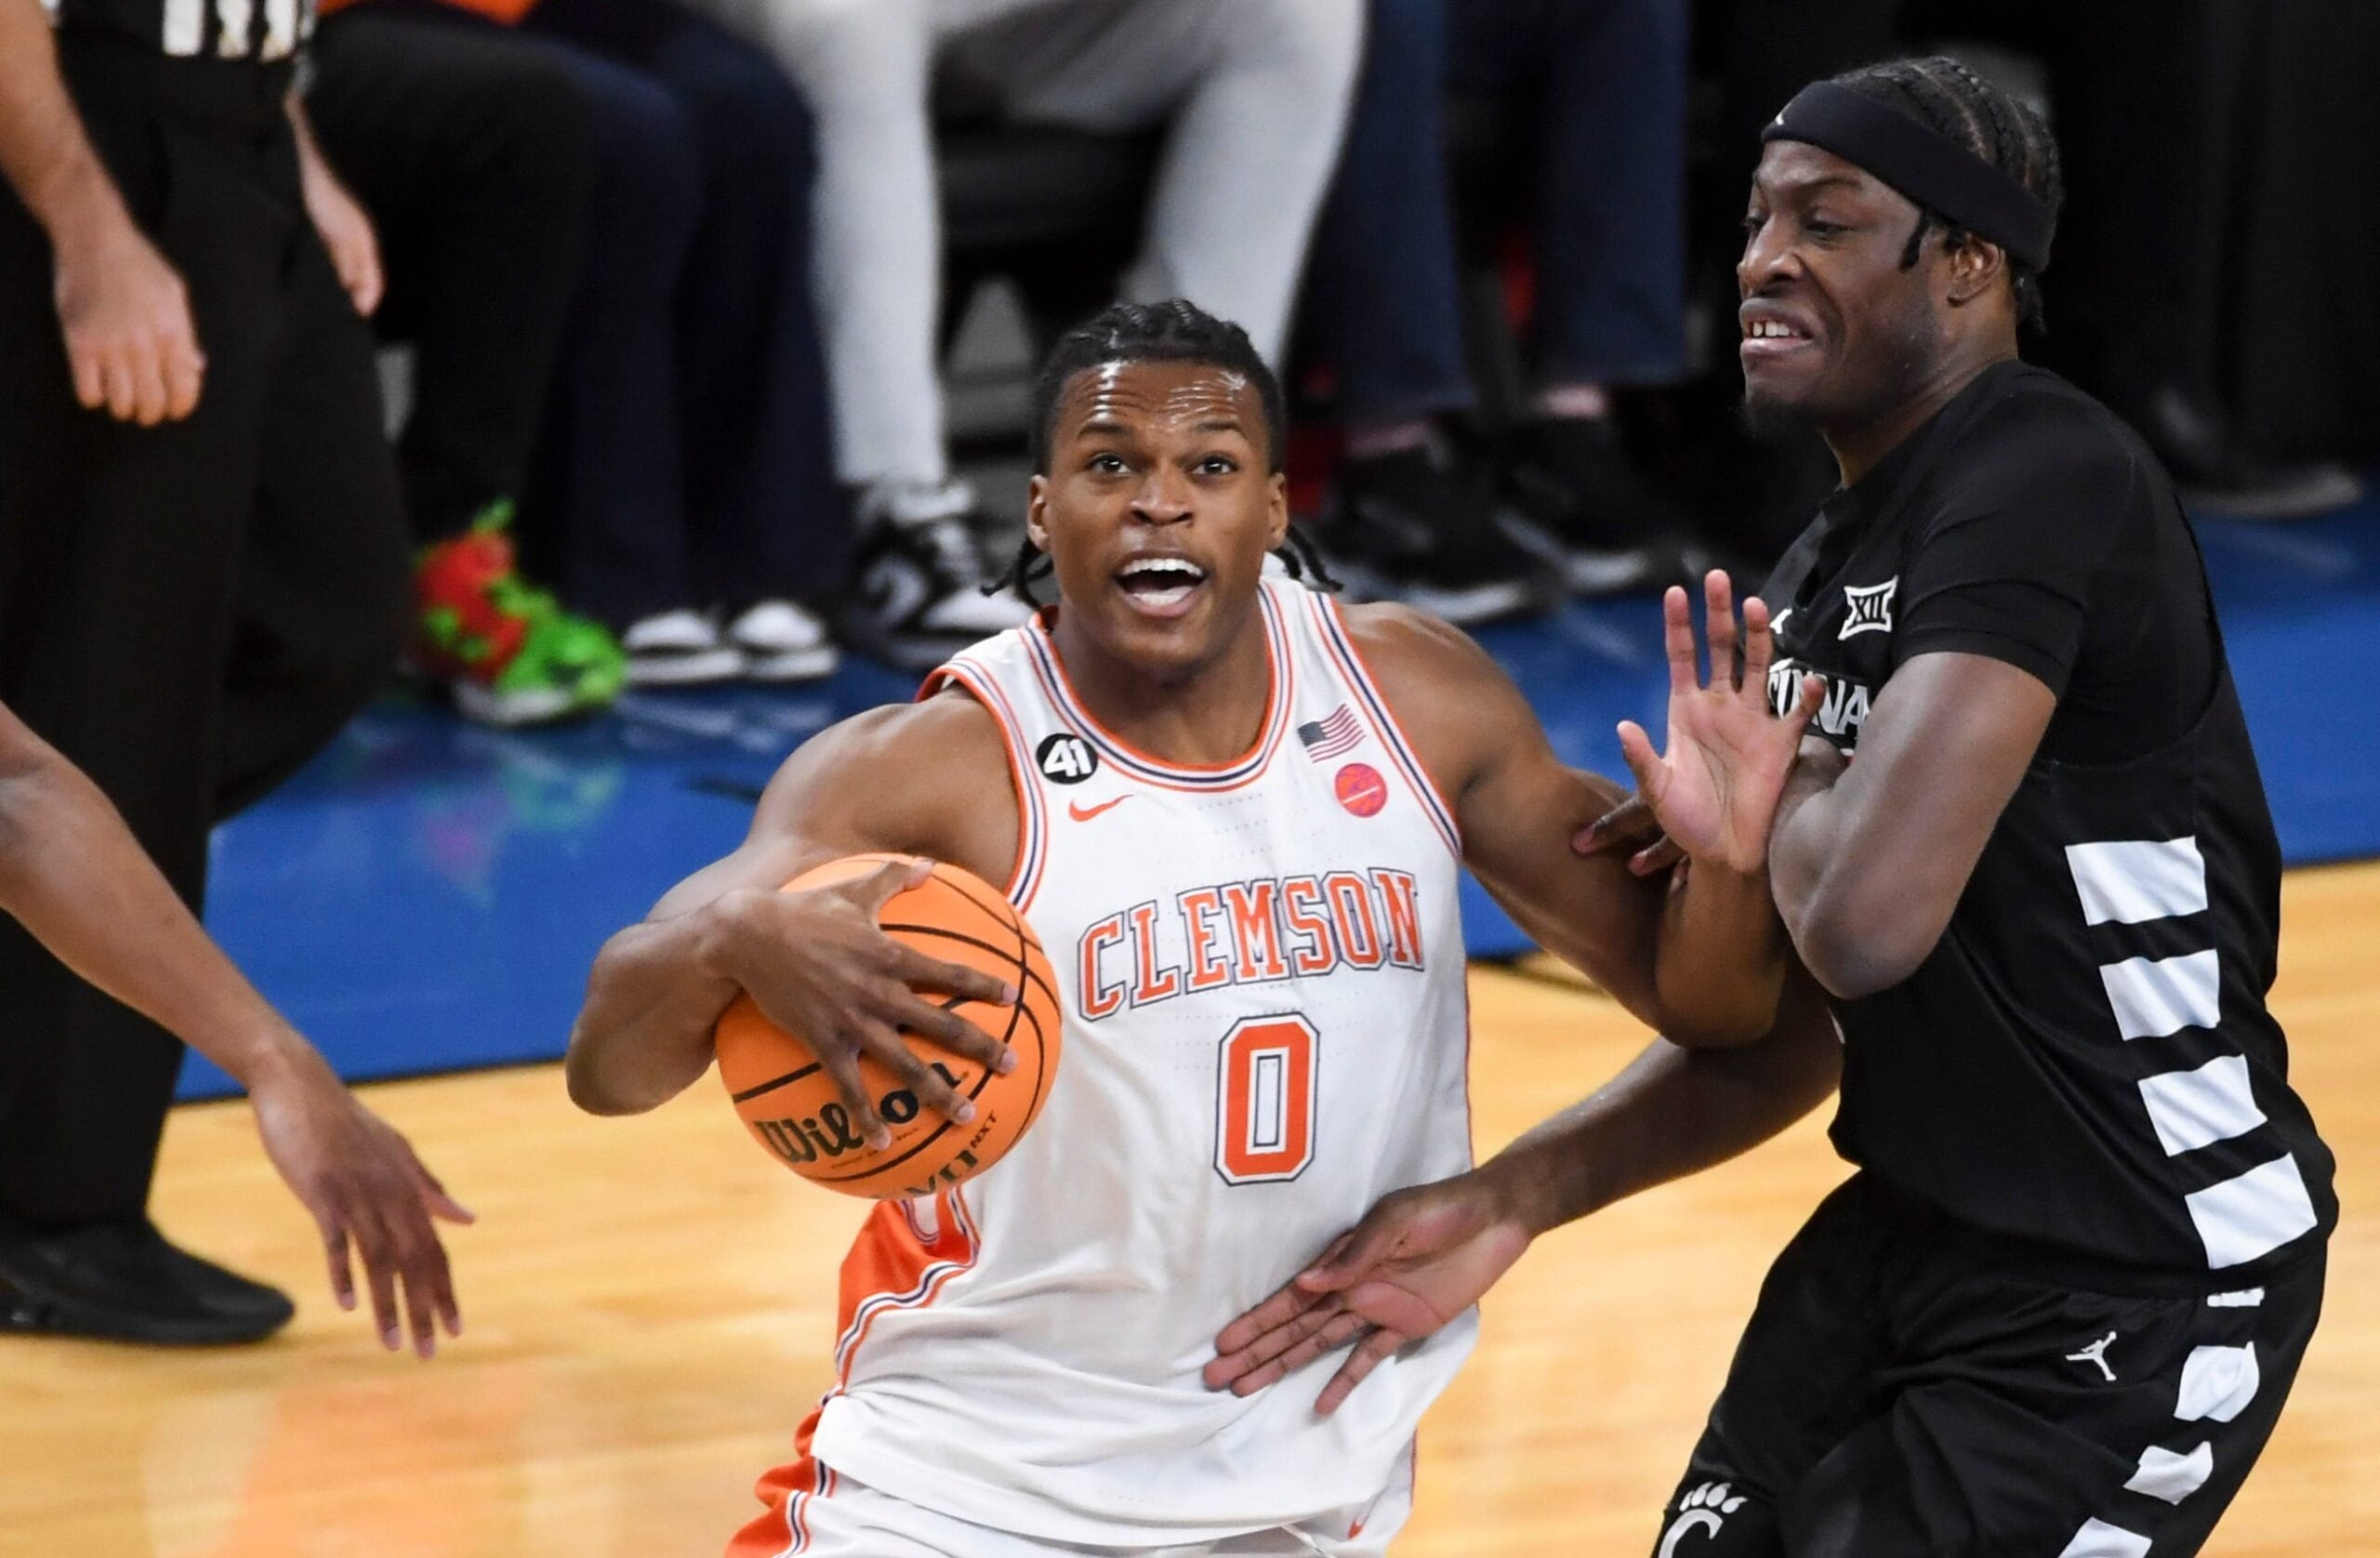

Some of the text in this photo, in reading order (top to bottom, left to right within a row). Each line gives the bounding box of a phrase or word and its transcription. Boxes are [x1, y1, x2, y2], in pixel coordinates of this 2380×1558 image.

[1043, 738, 1092, 777] 41
[1078, 866, 1424, 1023] CLEMSON
[1213, 1011, 1320, 1186] 0
